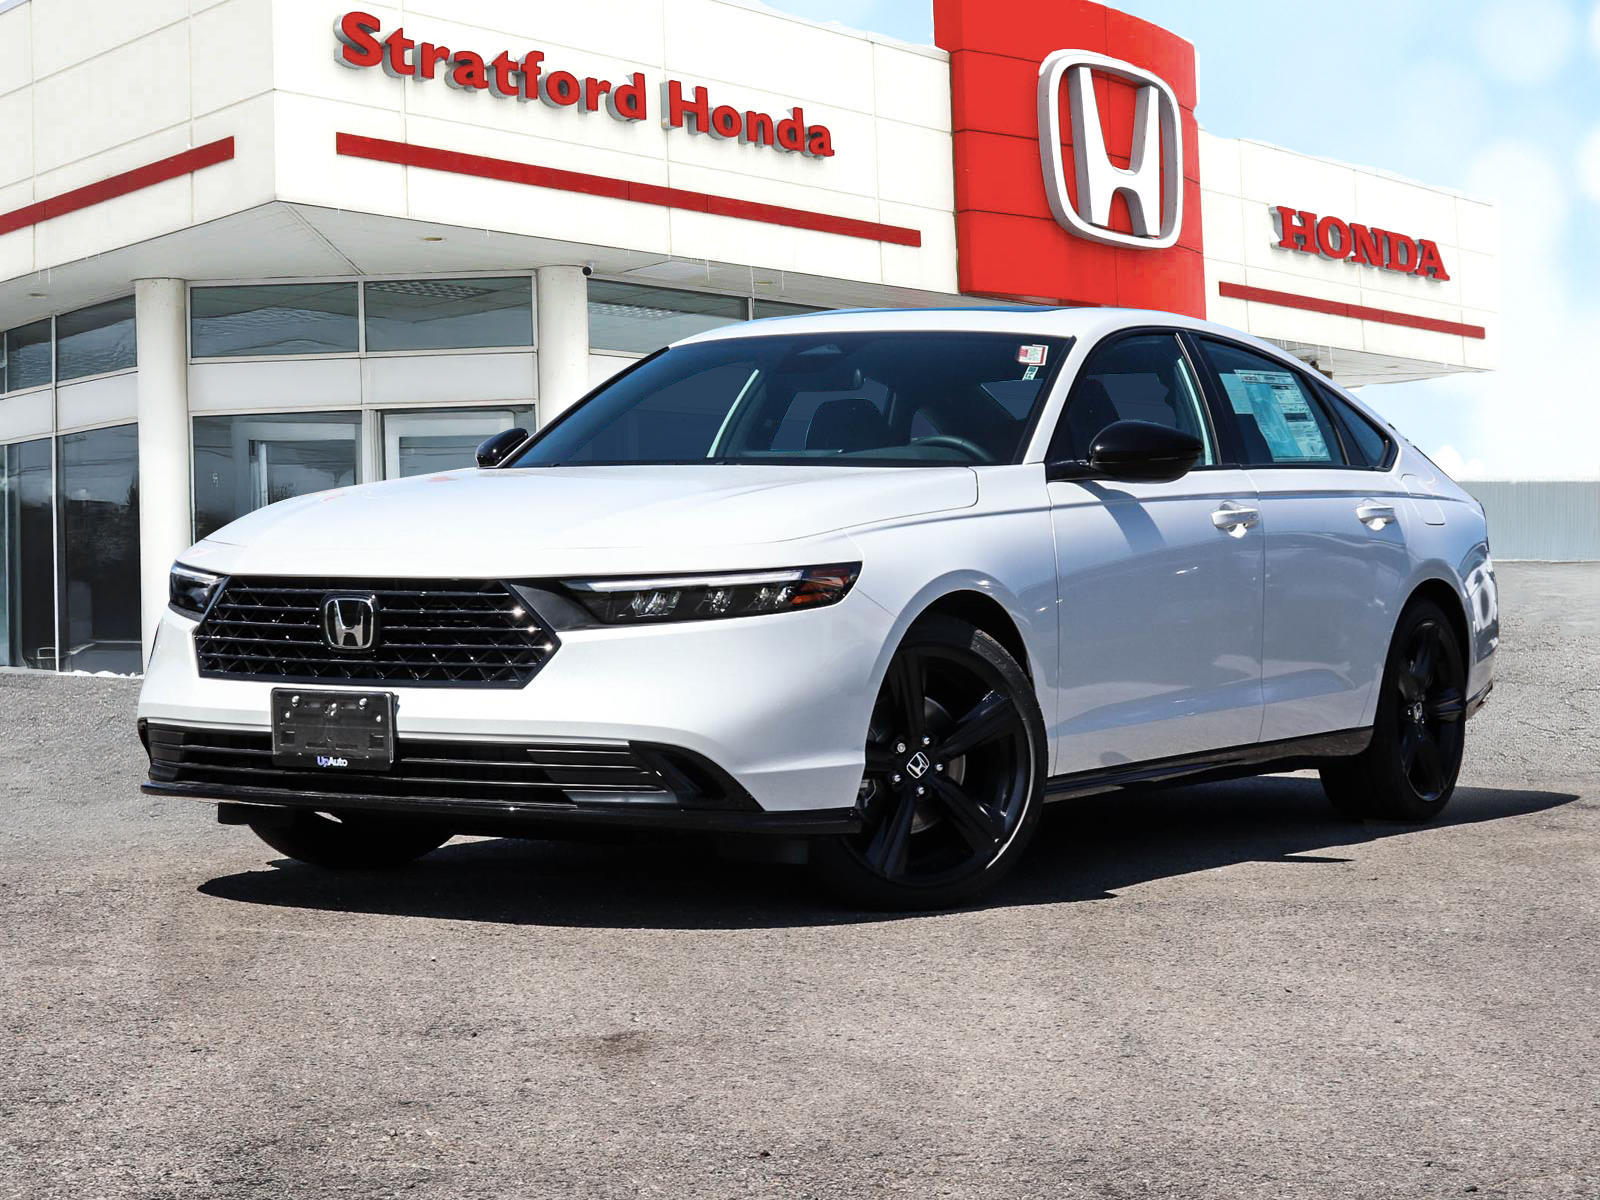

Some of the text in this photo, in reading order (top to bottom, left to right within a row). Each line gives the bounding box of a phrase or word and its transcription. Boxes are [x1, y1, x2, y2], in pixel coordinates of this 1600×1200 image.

[337, 11, 835, 159] Stratford Honda
[1270, 205, 1450, 282] HONDA
